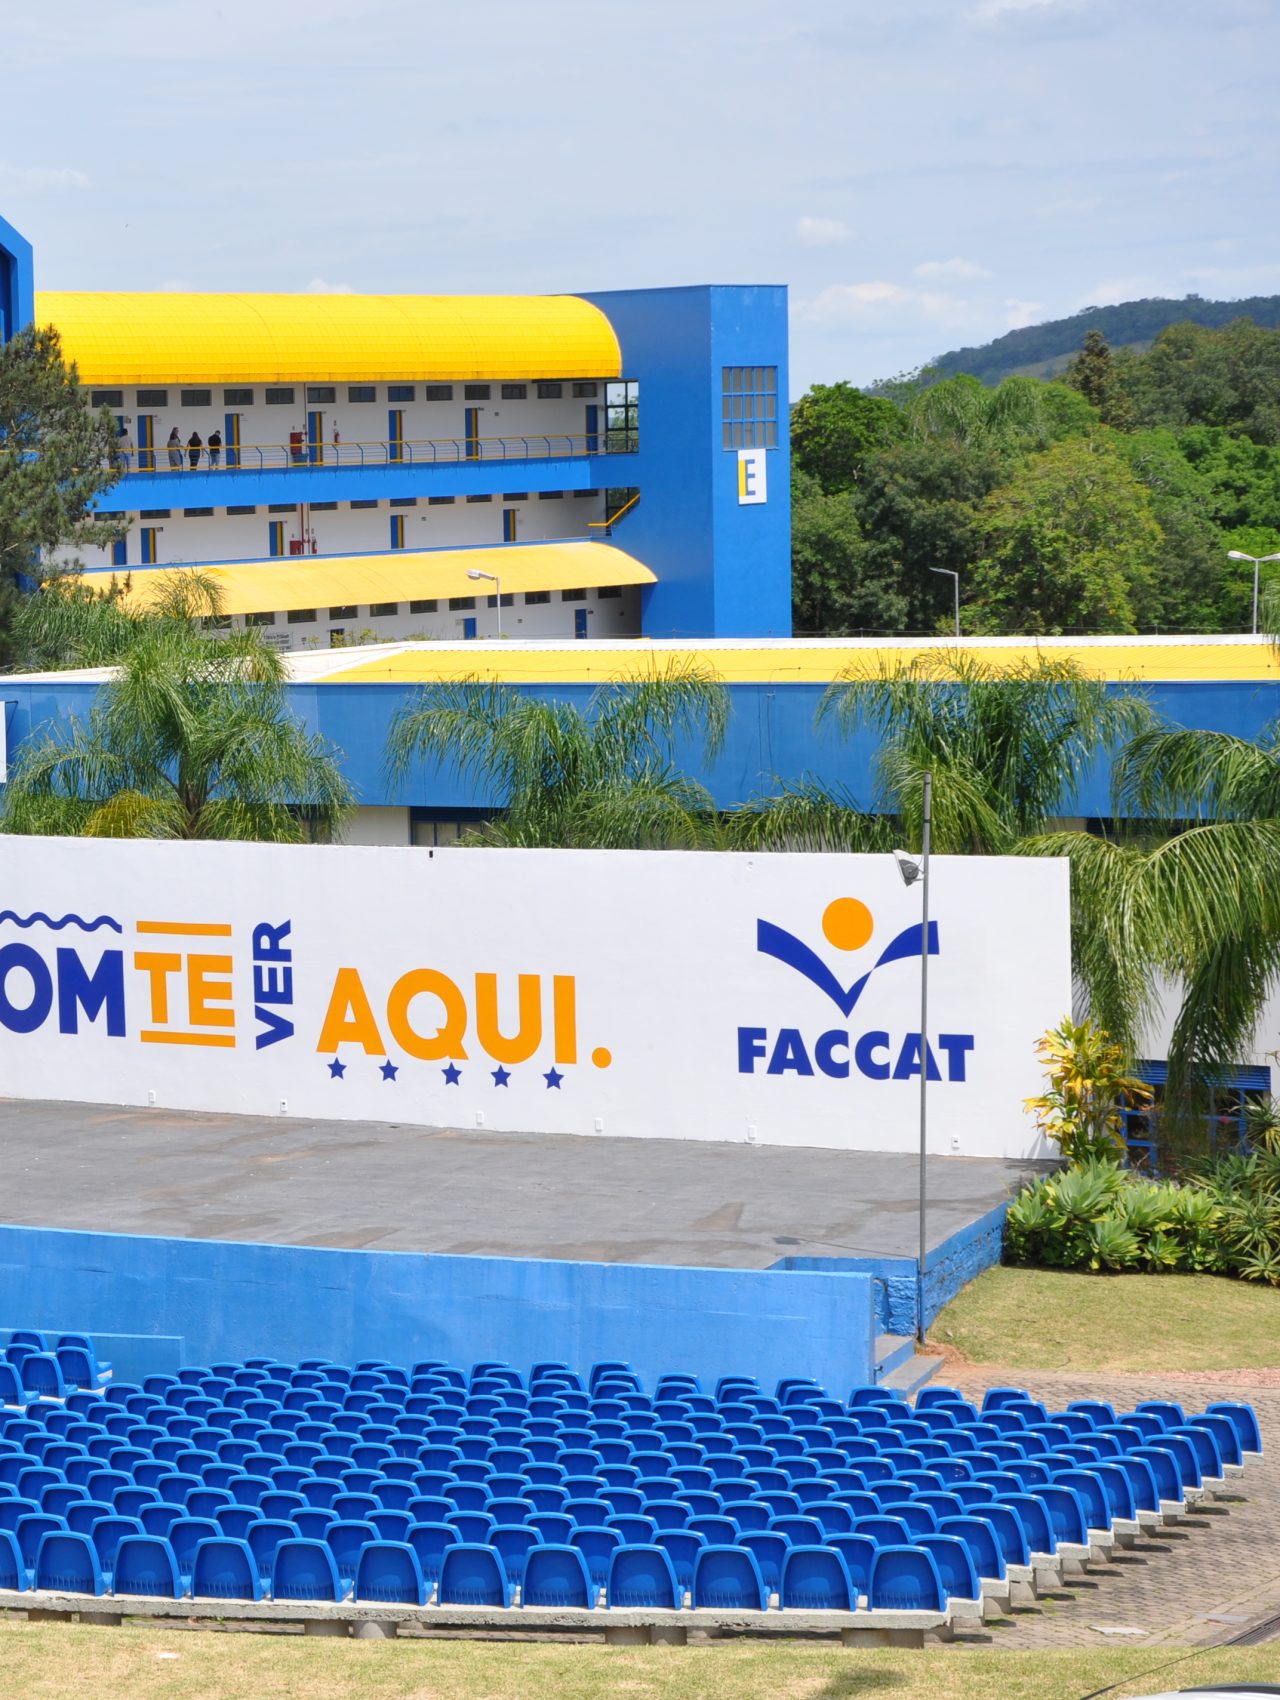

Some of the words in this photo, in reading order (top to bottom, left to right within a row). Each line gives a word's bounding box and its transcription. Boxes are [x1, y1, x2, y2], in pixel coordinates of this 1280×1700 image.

[745, 459, 756, 496] E
[134, 952, 235, 1027] TE
[253, 921, 293, 1050] VER
[317, 968, 611, 1068] AQUI.
[738, 1028, 974, 1082] FACCAT
